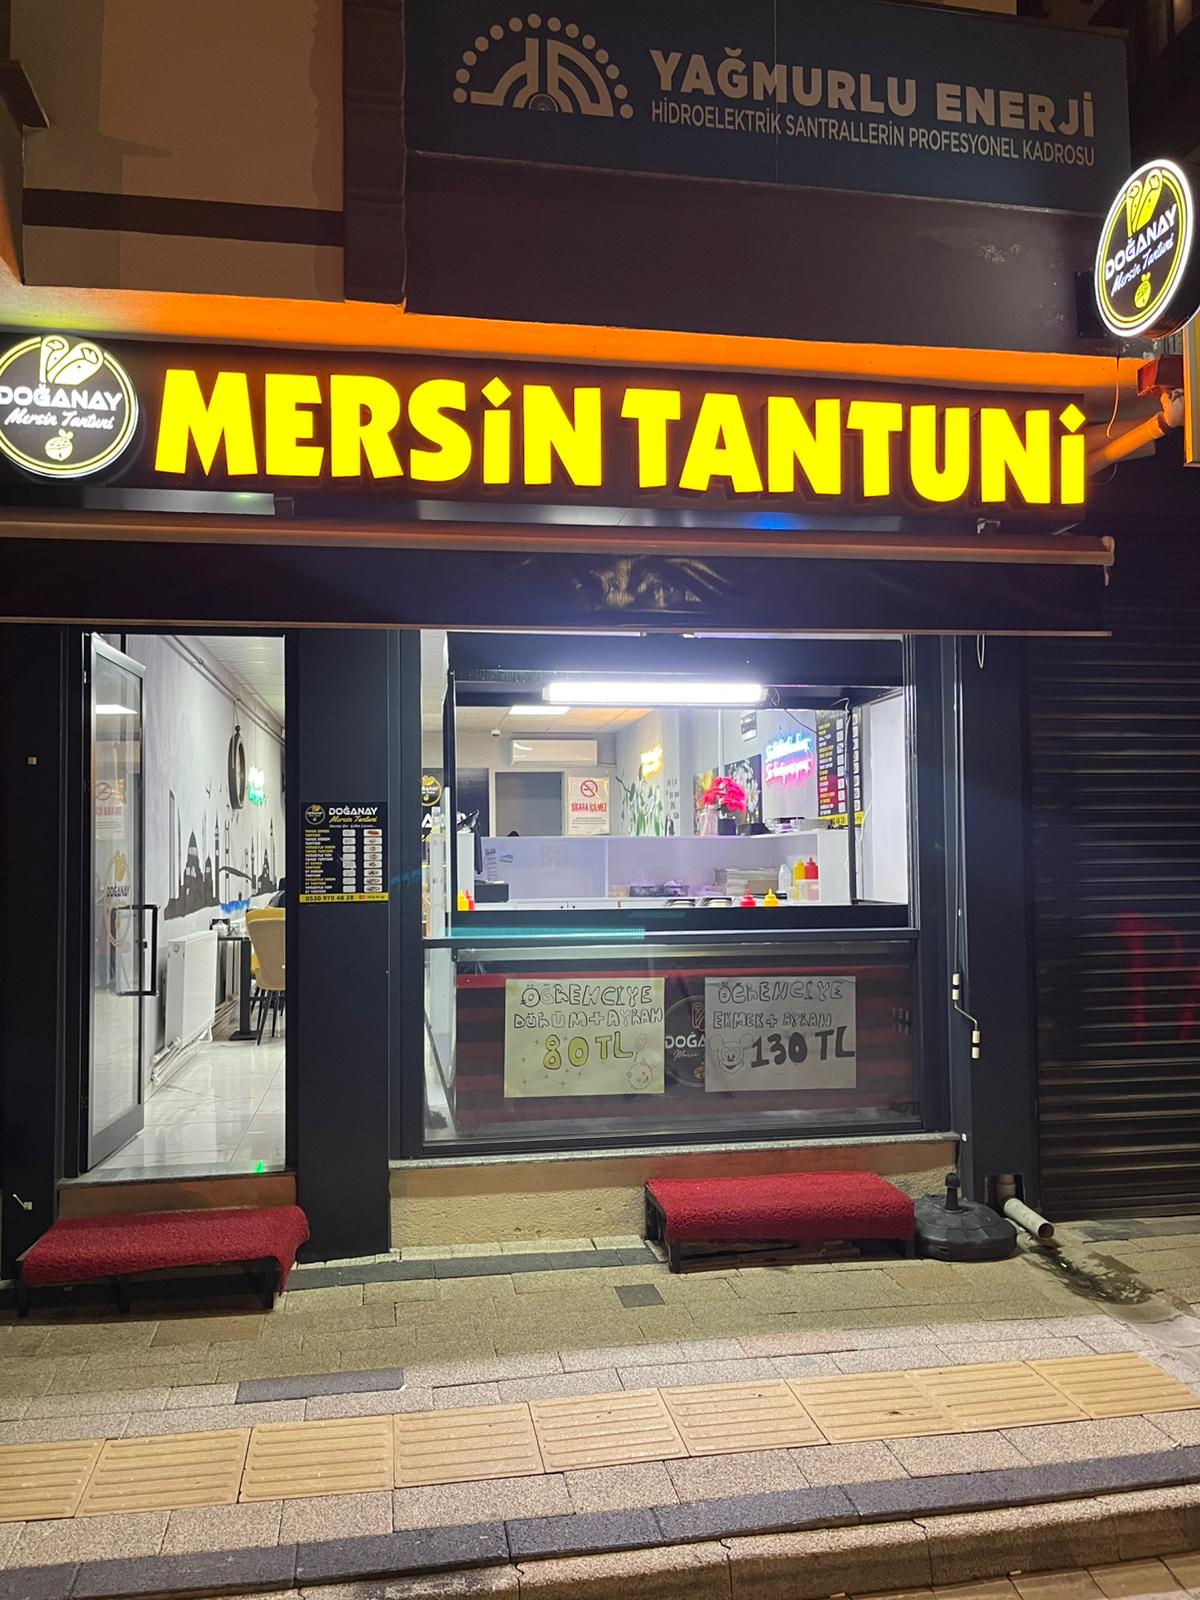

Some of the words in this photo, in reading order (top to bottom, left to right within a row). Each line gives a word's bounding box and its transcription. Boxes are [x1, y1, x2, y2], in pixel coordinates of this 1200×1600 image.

[649, 46, 917, 117] YAĞMURLU
[936, 82, 1095, 138] ENERJİ
[651, 97, 782, 135] HİDROELEKTRİK
[785, 114, 905, 147] SANTRALLERİN
[908, 126, 1019, 159] PROFESYONEL
[1022, 140, 1095, 167] KADROSU
[1104, 203, 1178, 281] DOĞANAY
[1110, 262, 1141, 298] Mersin
[1142, 232, 1175, 271] Tantuni
[0, 382, 123, 412] DOĞANAY
[3, 407, 59, 427] Mersin
[61, 410, 116, 431] Tantuni
[328, 805, 378, 816] DOĞANAY
[520, 984, 653, 1008] ÖĞRENCİYE
[542, 1034, 590, 1071] 80
[595, 1030, 634, 1060] TL
[750, 1031, 809, 1069] 130
[814, 1025, 856, 1061] TL
